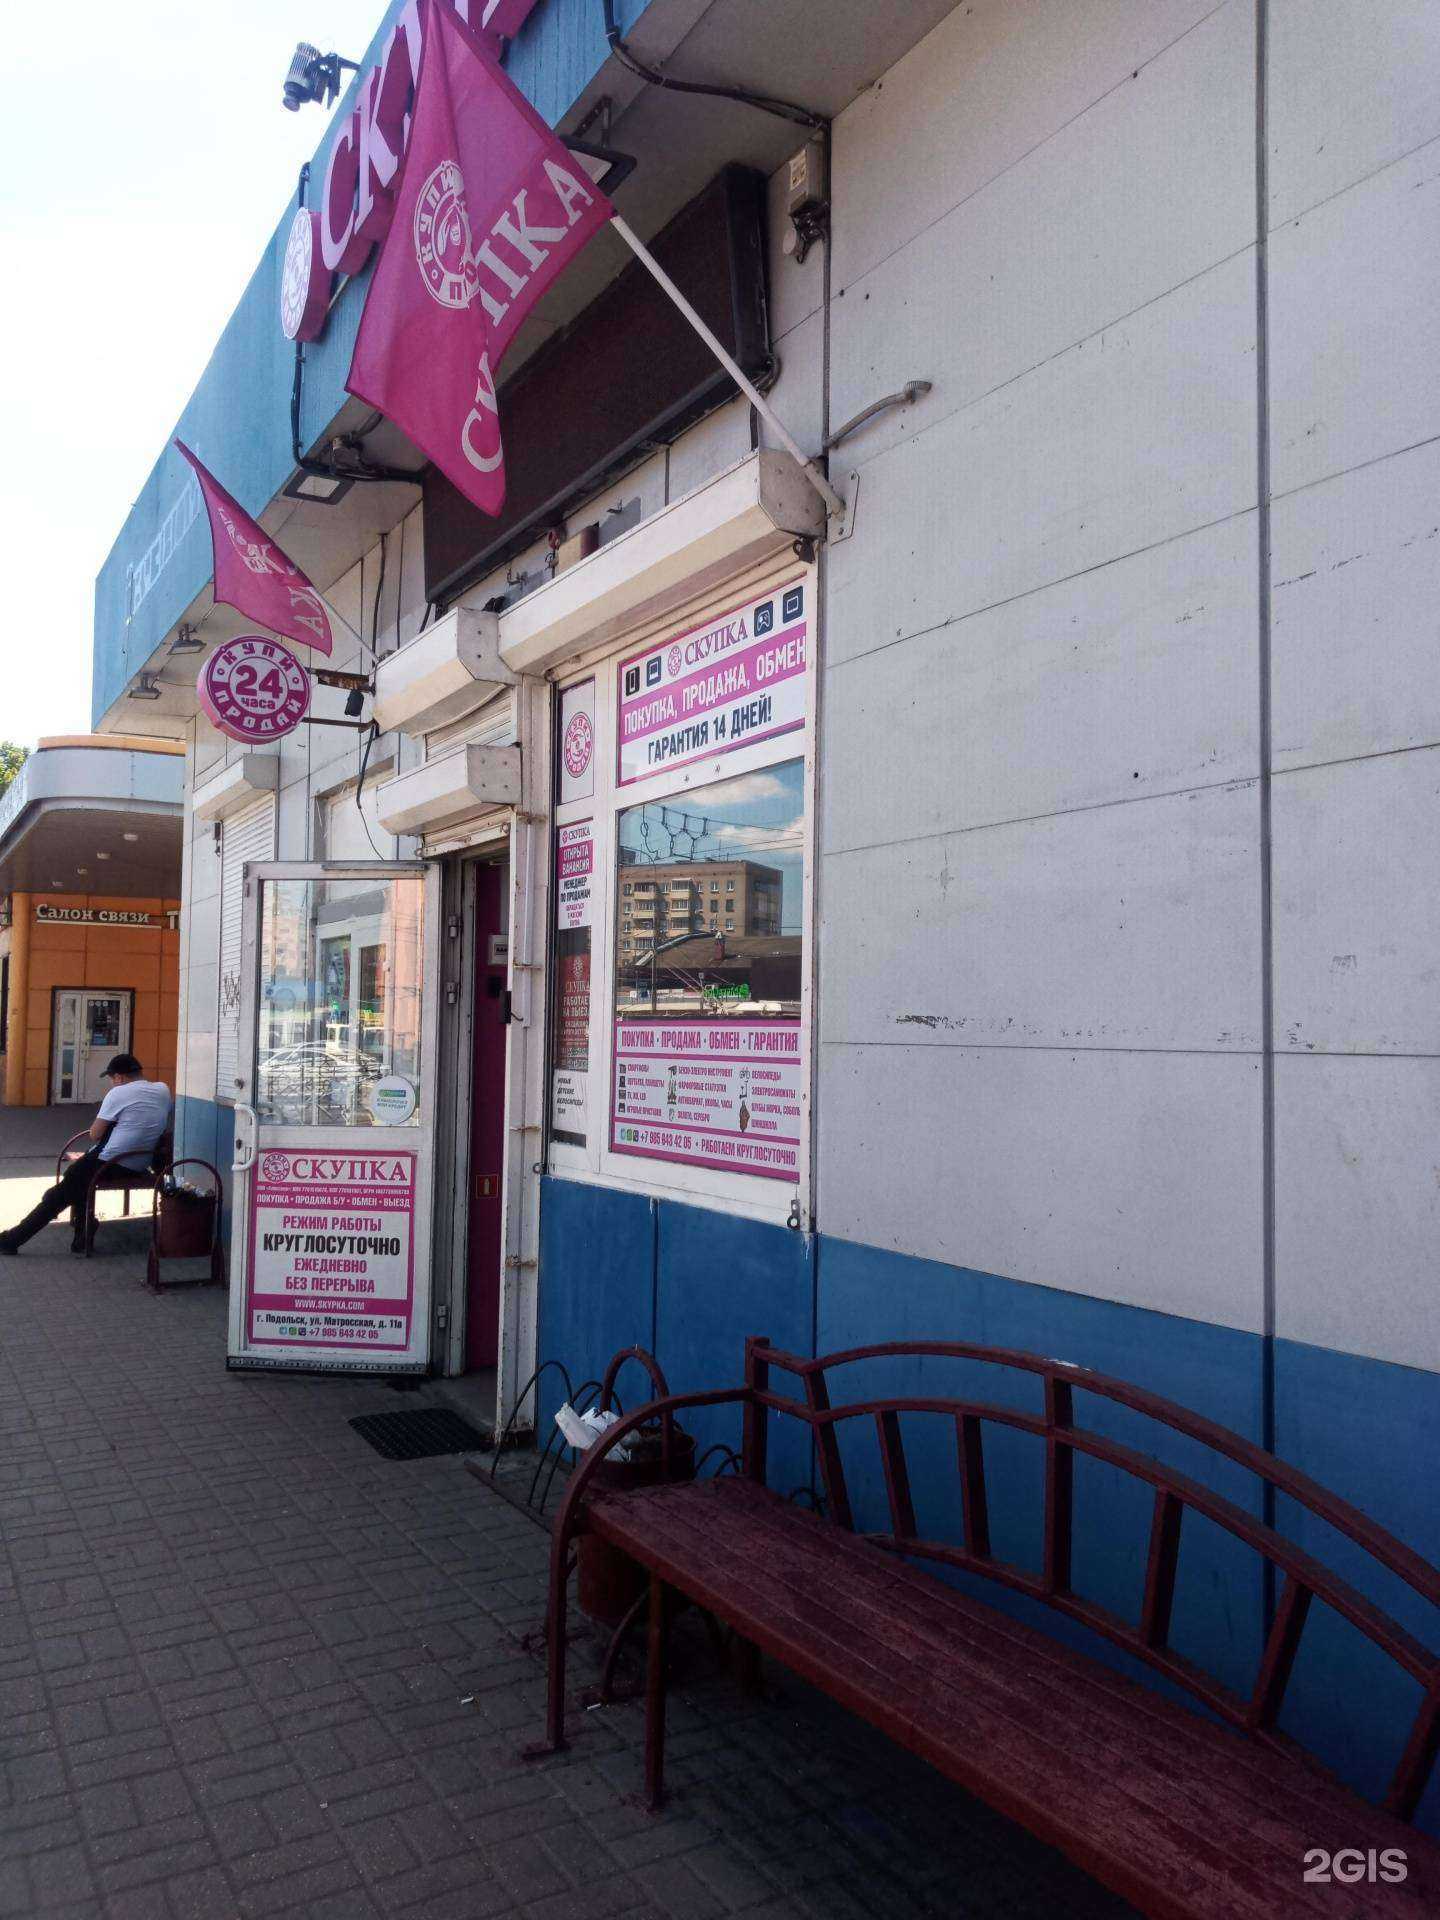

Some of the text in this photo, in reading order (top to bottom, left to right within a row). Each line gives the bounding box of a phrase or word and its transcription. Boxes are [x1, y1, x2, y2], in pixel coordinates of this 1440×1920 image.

[684, 618, 748, 666] СКУПКА
[222, 643, 295, 672] КУПИ
[236, 665, 283, 699] 24
[624, 636, 806, 735] ПОКУПКА, ПРОДАЖА, ОБМЕН
[648, 693, 772, 765] ГАРАНТИЯ 14 ДНЕЙ!
[36, 903, 150, 923] Салон связи
[621, 1031, 799, 1051] ПОКУПКА ПРОДАЖА ОБМЕН ГАРАНТИЯ
[701, 1140, 736, 1157] РАБОТАЕМ
[736, 1147, 796, 1166] КРУГЛОСУТОЧНО
[292, 1158, 408, 1181] СКУПКА
[256, 1194, 289, 1204] ПОКУПКА
[295, 1196, 332, 1206] ПРОДАЖА
[352, 1197, 378, 1206] ОБМЕН
[383, 1198, 411, 1208] ВЫЕЗД
[282, 1215, 382, 1232] РЕЖИМ РАБОТЫ
[263, 1233, 401, 1256] КРУГЛОСУТОЧНО
[294, 1258, 367, 1274] ЕЖЕДНЕВНО
[285, 1276, 375, 1293] БЕЗ ПЕРЕРЫВА
[265, 1314, 308, 1326] Подольск,
[310, 1316, 322, 1326] ул.
[324, 1316, 376, 1329] Матросская,
[309, 1328, 320, 1337] +7
